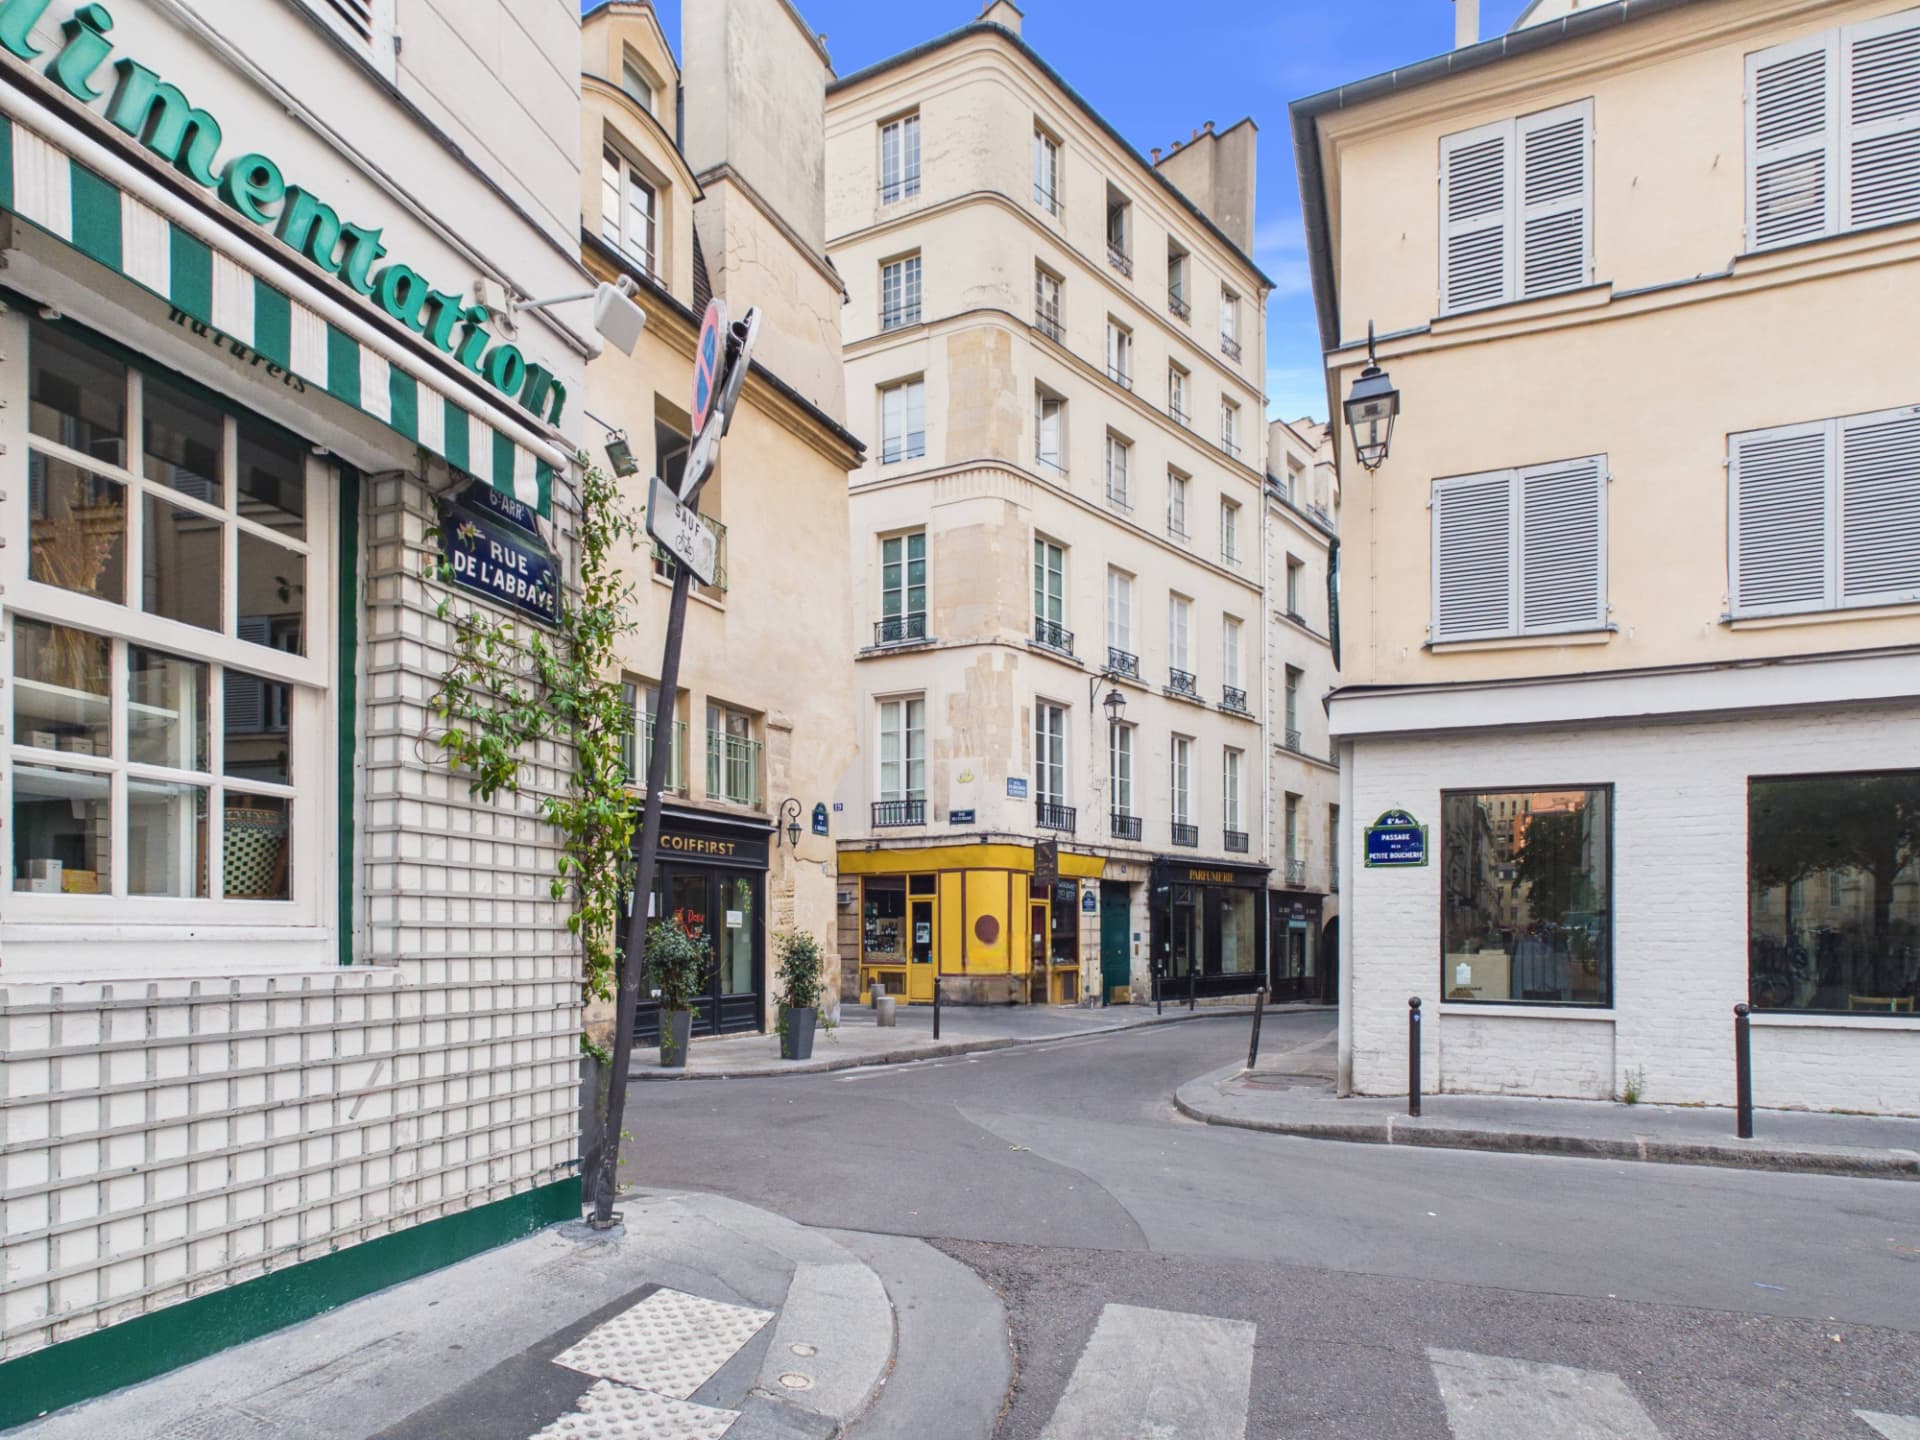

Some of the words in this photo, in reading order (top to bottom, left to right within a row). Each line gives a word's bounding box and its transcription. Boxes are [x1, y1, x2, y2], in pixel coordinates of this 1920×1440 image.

[674, 503, 701, 537] SAUF
[454, 549, 477, 578] DE
[490, 540, 529, 576] RUE
[659, 834, 736, 857] COIFFIRST
[1381, 833, 1411, 841] PASSAGE
